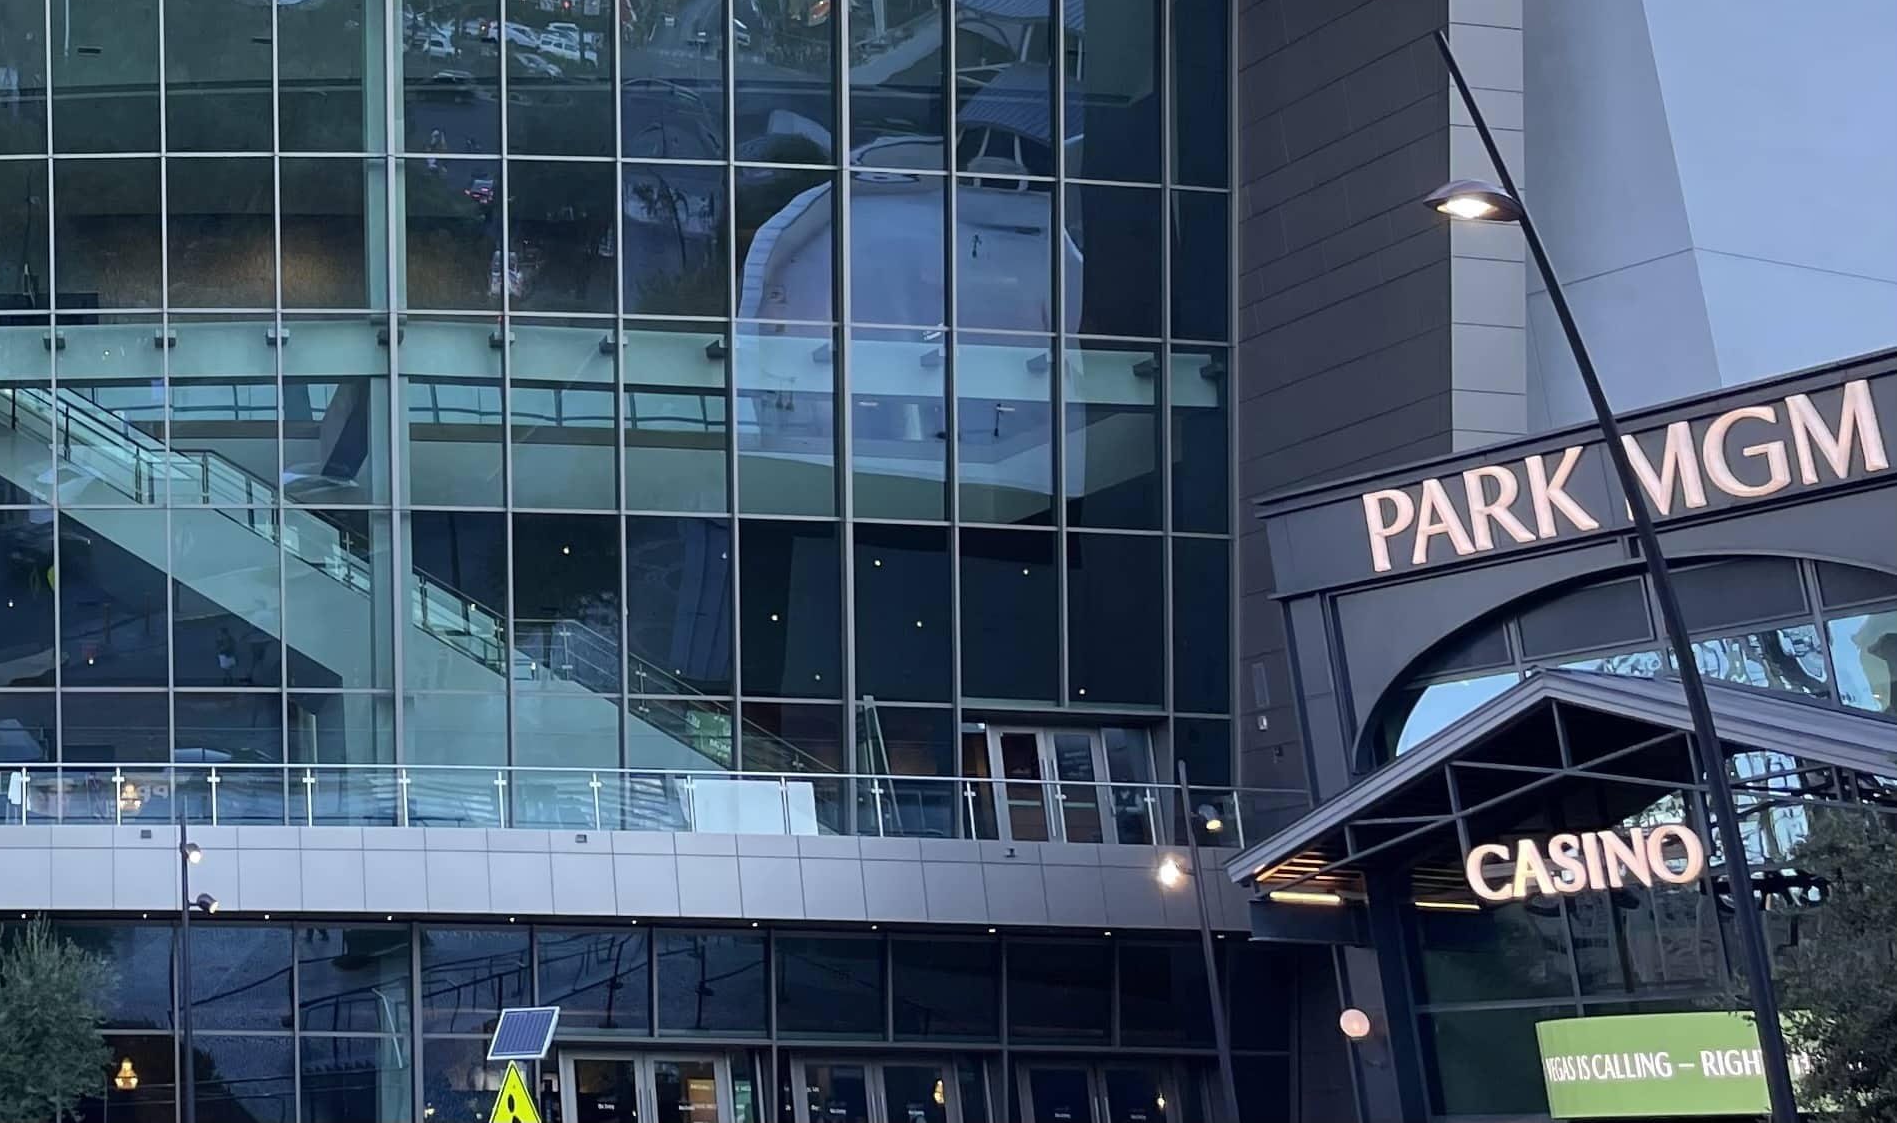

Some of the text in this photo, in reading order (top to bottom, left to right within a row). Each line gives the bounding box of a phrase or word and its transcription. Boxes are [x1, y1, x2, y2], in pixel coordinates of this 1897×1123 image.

[1362, 379, 1890, 573] PARK MGM
[1465, 823, 1705, 904] CASINO
[1545, 1055, 1576, 1082] VEGAS
[1576, 1054, 1590, 1081] IS
[1592, 1051, 1673, 1080] CALLING
